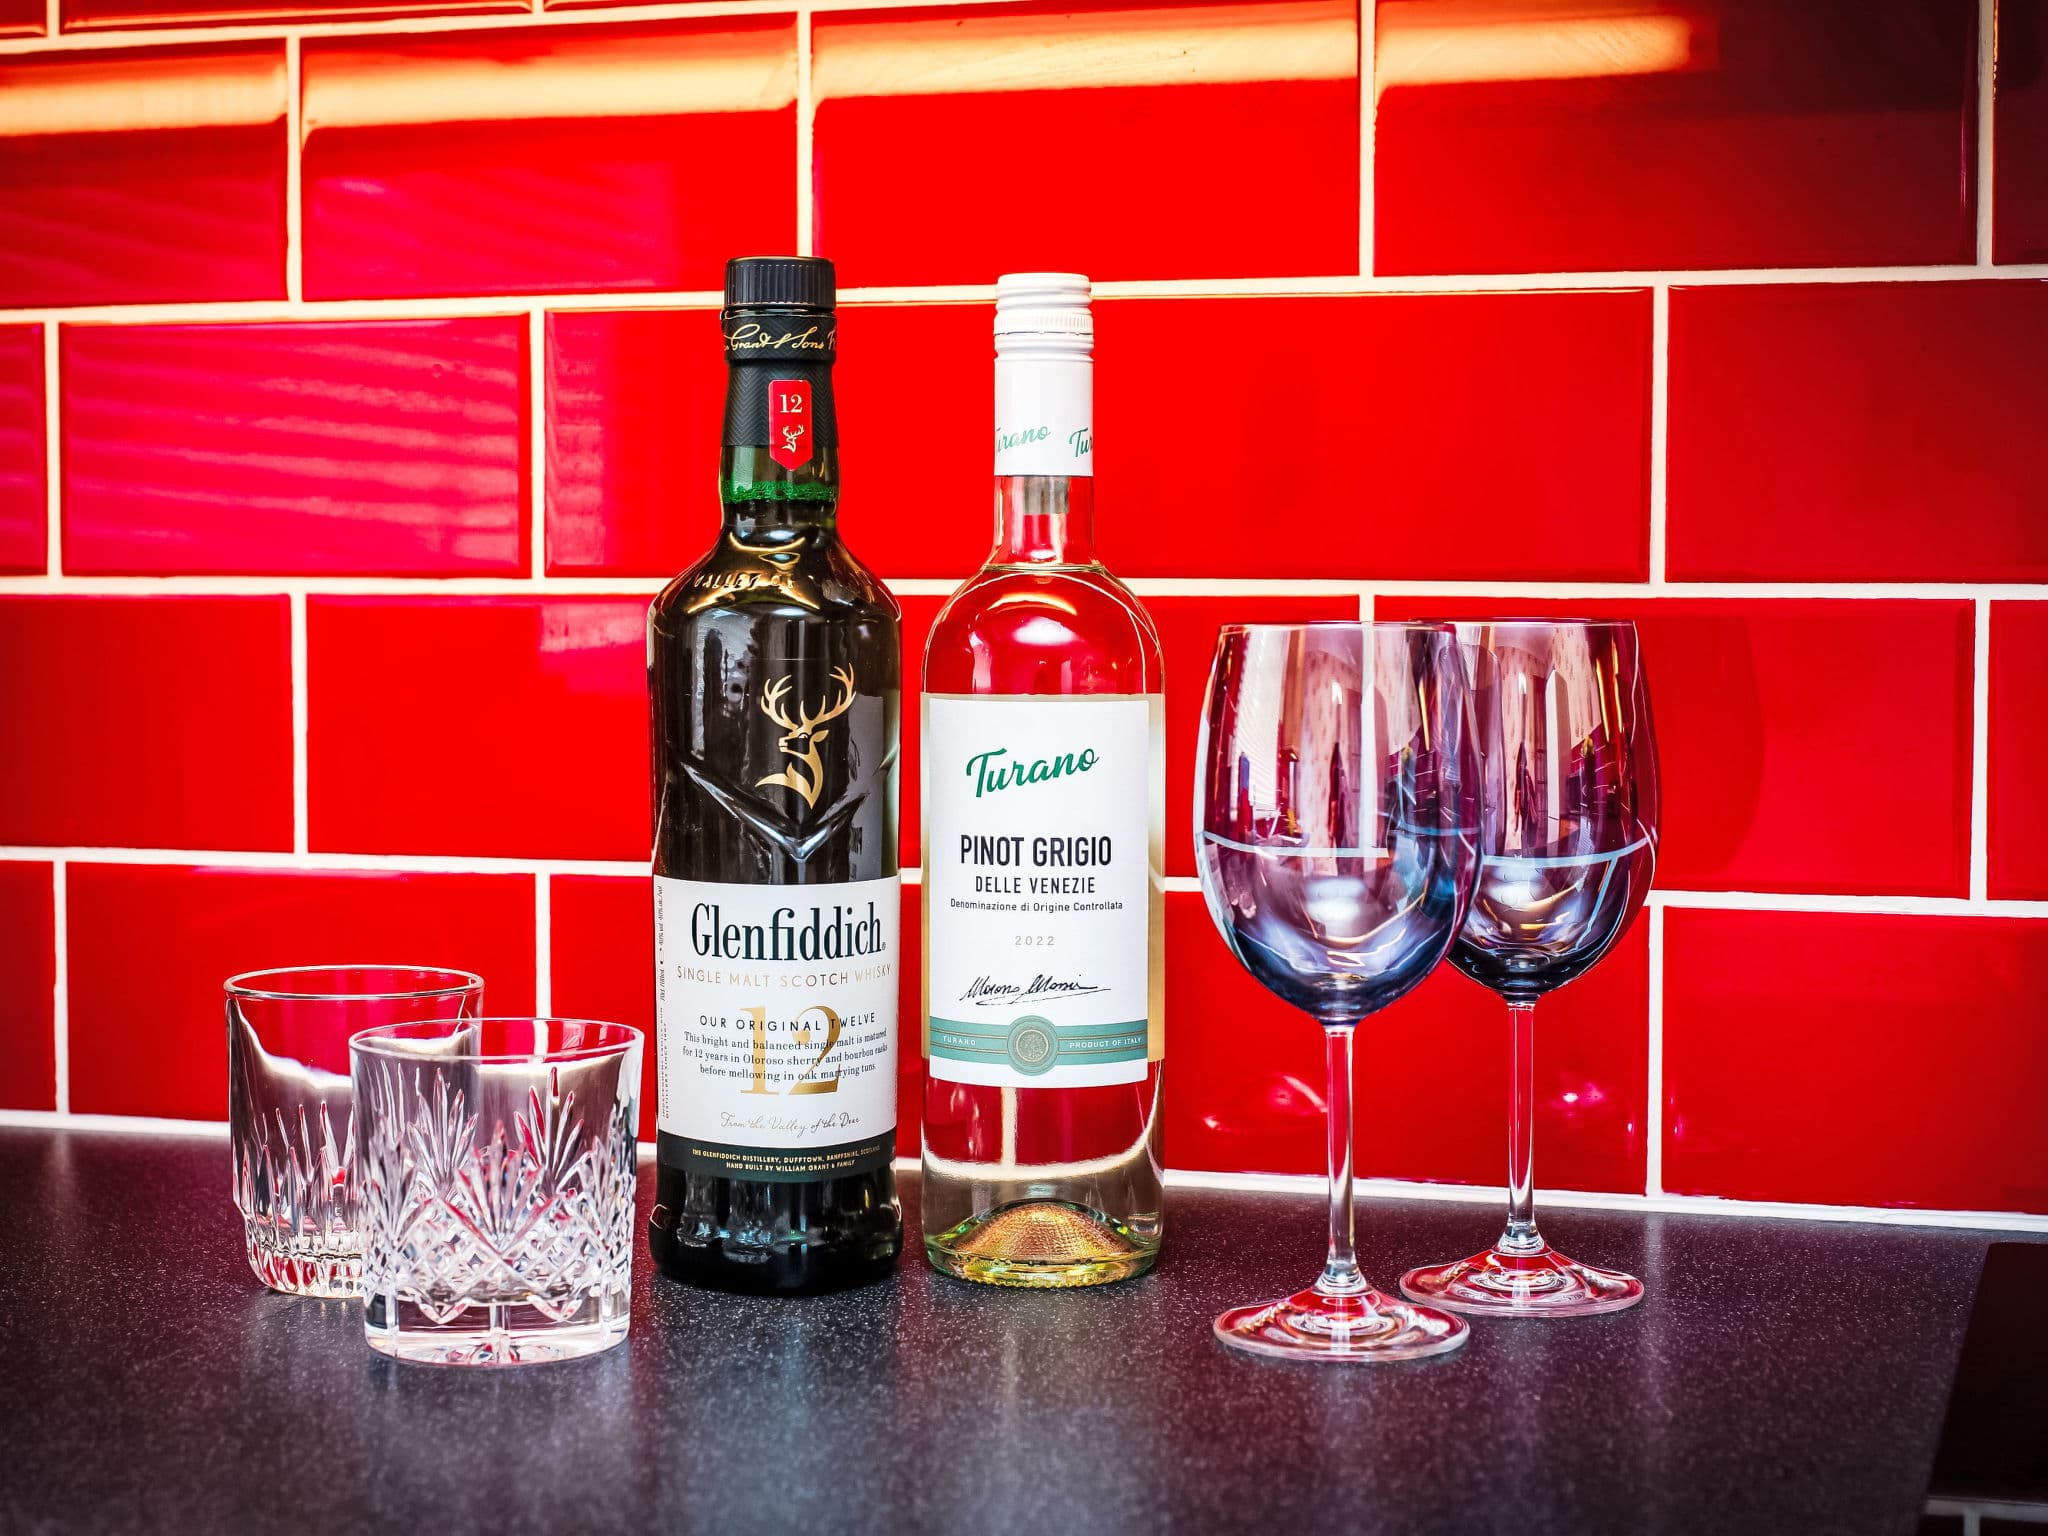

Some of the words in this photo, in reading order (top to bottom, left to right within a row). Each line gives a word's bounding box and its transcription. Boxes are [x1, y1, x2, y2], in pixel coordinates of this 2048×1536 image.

[791, 326, 825, 350] Sons
[779, 394, 803, 414] 12
[996, 426, 1051, 453] urano
[966, 748, 1100, 798] Turano
[960, 834, 1024, 866] PINOT
[1032, 836, 1112, 866] GRIGIO
[975, 876, 1022, 894] DELLE
[1030, 876, 1096, 894] VENEZIE
[950, 898, 1016, 912] Denominazione
[1021, 902, 1030, 912] di
[1034, 902, 1070, 914] Origine
[1073, 900, 1123, 912] Controllata
[691, 901, 882, 962] Glenfiddich
[1014, 935, 1056, 946] 2022
[677, 966, 721, 984] SINGLE
[730, 972, 768, 988] MALT
[780, 969, 848, 988] SCOTCH
[854, 963, 891, 982] WHISKY
[700, 1014, 727, 1030] OUR
[736, 1018, 822, 1032] ORIGINAL
[830, 1012, 876, 1030] TWELVE
[684, 1031, 700, 1044] This
[700, 1032, 728, 1050] bright
[731, 1037, 749, 1050] and
[752, 1039, 802, 1050] balanced
[804, 1038, 834, 1052] single
[836, 1035, 854, 1048] malt
[856, 1034, 863, 1044] is
[864, 1028, 887, 1043] matured
[738, 1005, 841, 1096] 12
[942, 1036, 976, 1046] TURANO
[1070, 1040, 1110, 1049] PRODUCT
[1112, 1039, 1123, 1047] OF
[1124, 1036, 1142, 1046] ITALY
[682, 1045, 693, 1056] for
[694, 1048, 704, 1059] 12
[705, 1052, 729, 1064] years
[730, 1054, 740, 1063] in
[742, 1054, 784, 1066] Oloroso
[787, 1054, 822, 1067] sherry
[825, 1053, 842, 1064] and
[844, 1048, 874, 1062] bourbon
[700, 1064, 726, 1077] before
[728, 1068, 780, 1082] mellowing
[784, 1070, 795, 1080] in
[798, 1069, 818, 1080] oak
[820, 1065, 860, 1080] marrying
[720, 1112, 749, 1128] From
[749, 1113, 766, 1129] the
[768, 1114, 808, 1138] Valley
[810, 1118, 823, 1134] of
[822, 1112, 836, 1128] the
[692, 1148, 702, 1156] THE
[702, 1150, 741, 1160] GLENFIDDICH
[742, 1154, 782, 1164] DISTILLERY,
[808, 1163, 829, 1171] GRANT
[836, 1160, 855, 1168] FAMILY
